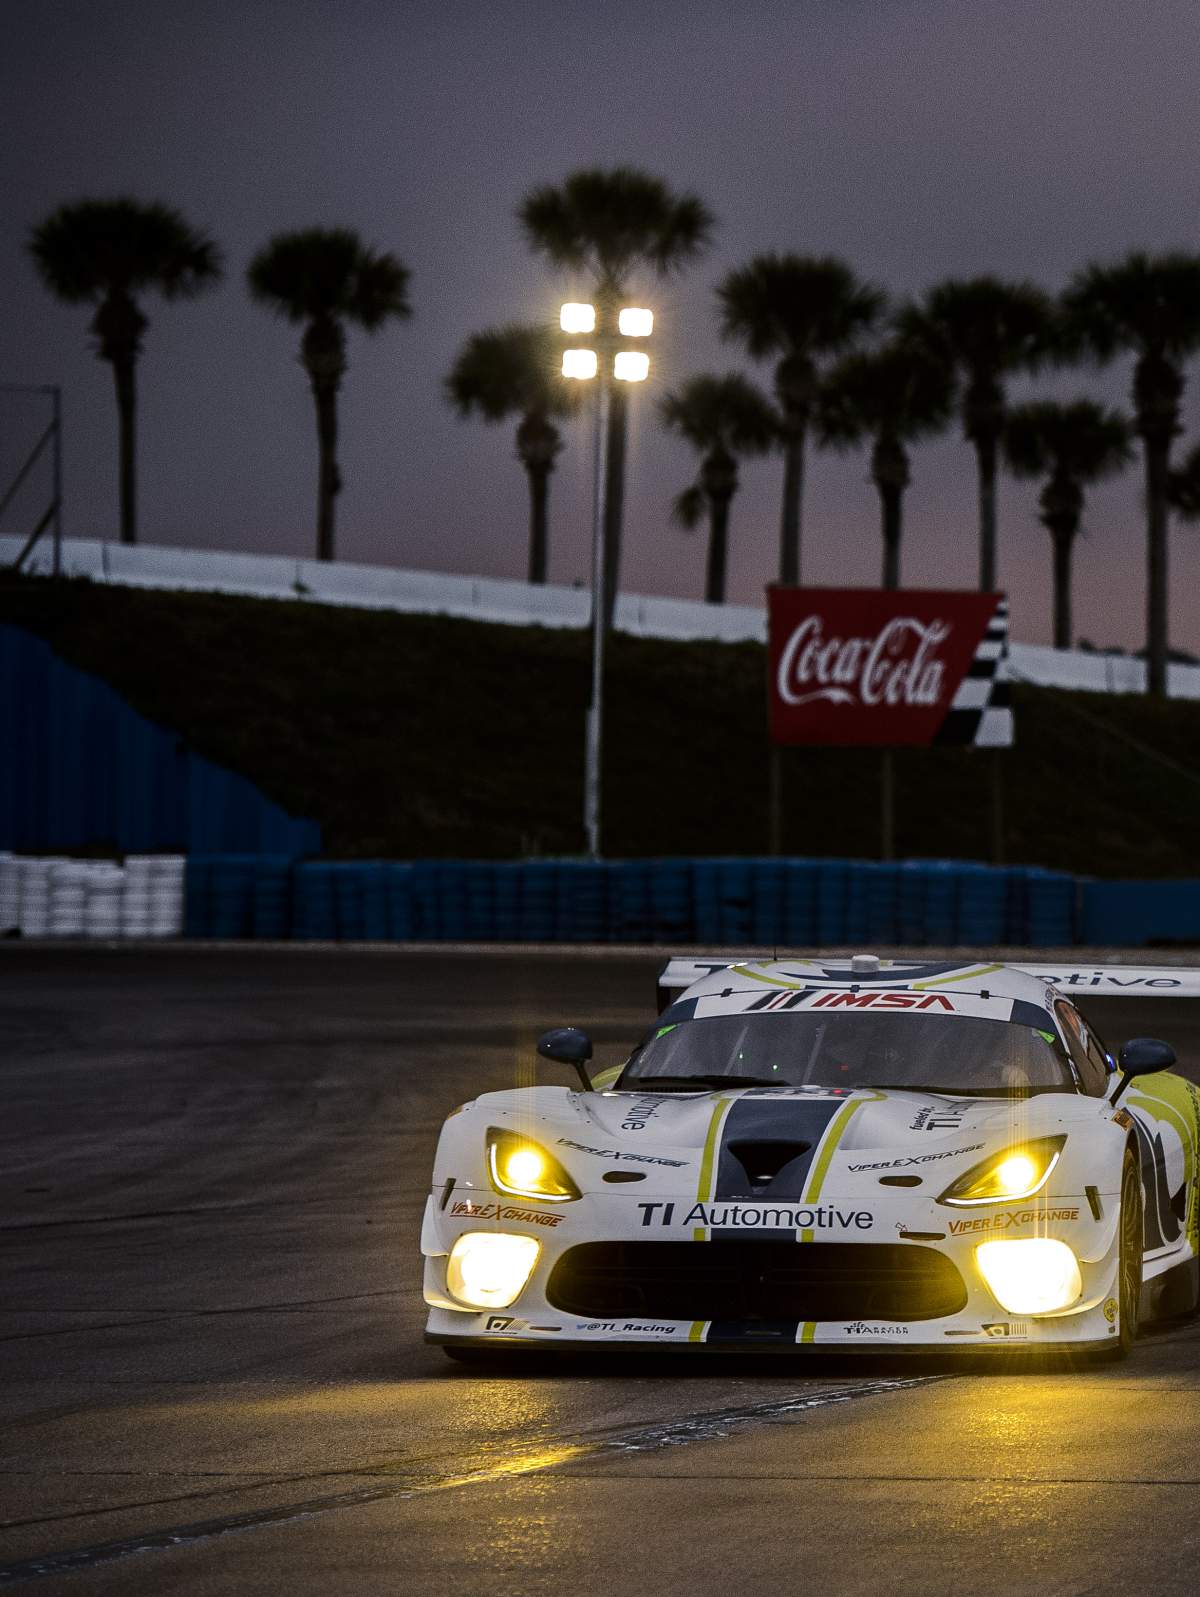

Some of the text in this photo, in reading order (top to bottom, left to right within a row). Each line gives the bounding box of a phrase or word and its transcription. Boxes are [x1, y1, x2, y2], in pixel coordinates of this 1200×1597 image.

[810, 992, 955, 1011] IMSA
[637, 1202, 874, 1229] TI Automotive
